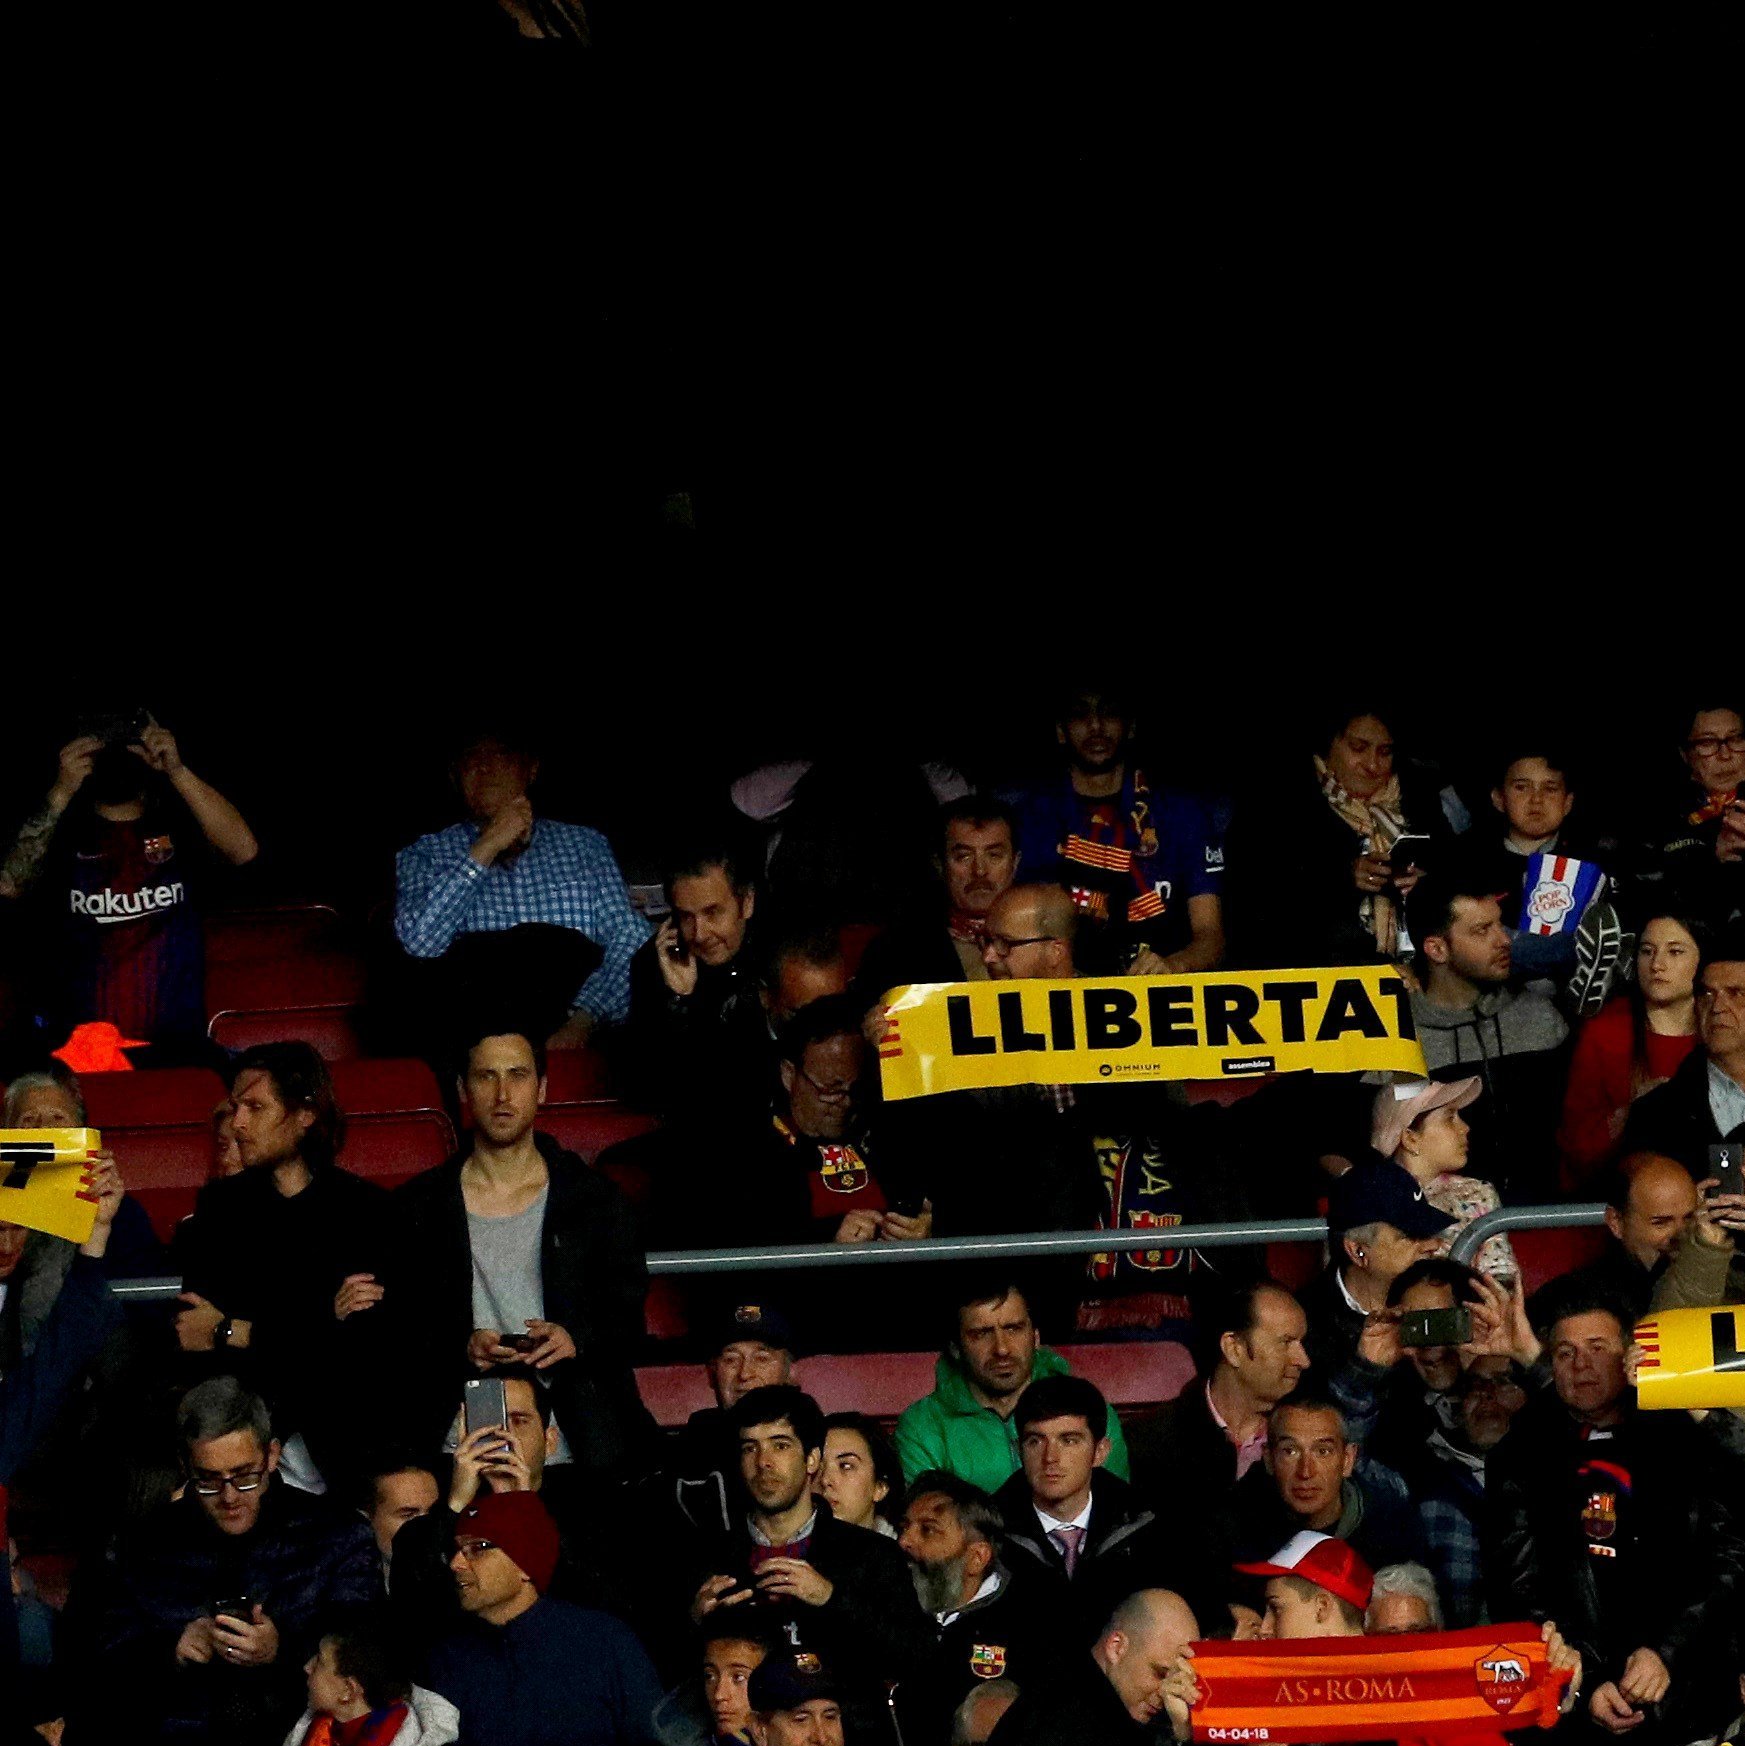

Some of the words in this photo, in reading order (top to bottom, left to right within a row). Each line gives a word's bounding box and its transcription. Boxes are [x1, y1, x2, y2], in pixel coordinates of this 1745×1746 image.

[70, 882, 184, 916] Rakuten
[1538, 889, 1562, 903] POP
[1535, 898, 1568, 912] CORN
[948, 977, 1414, 1057] LLIBERTAT
[1207, 1727, 1269, 1741] 04-04-18
